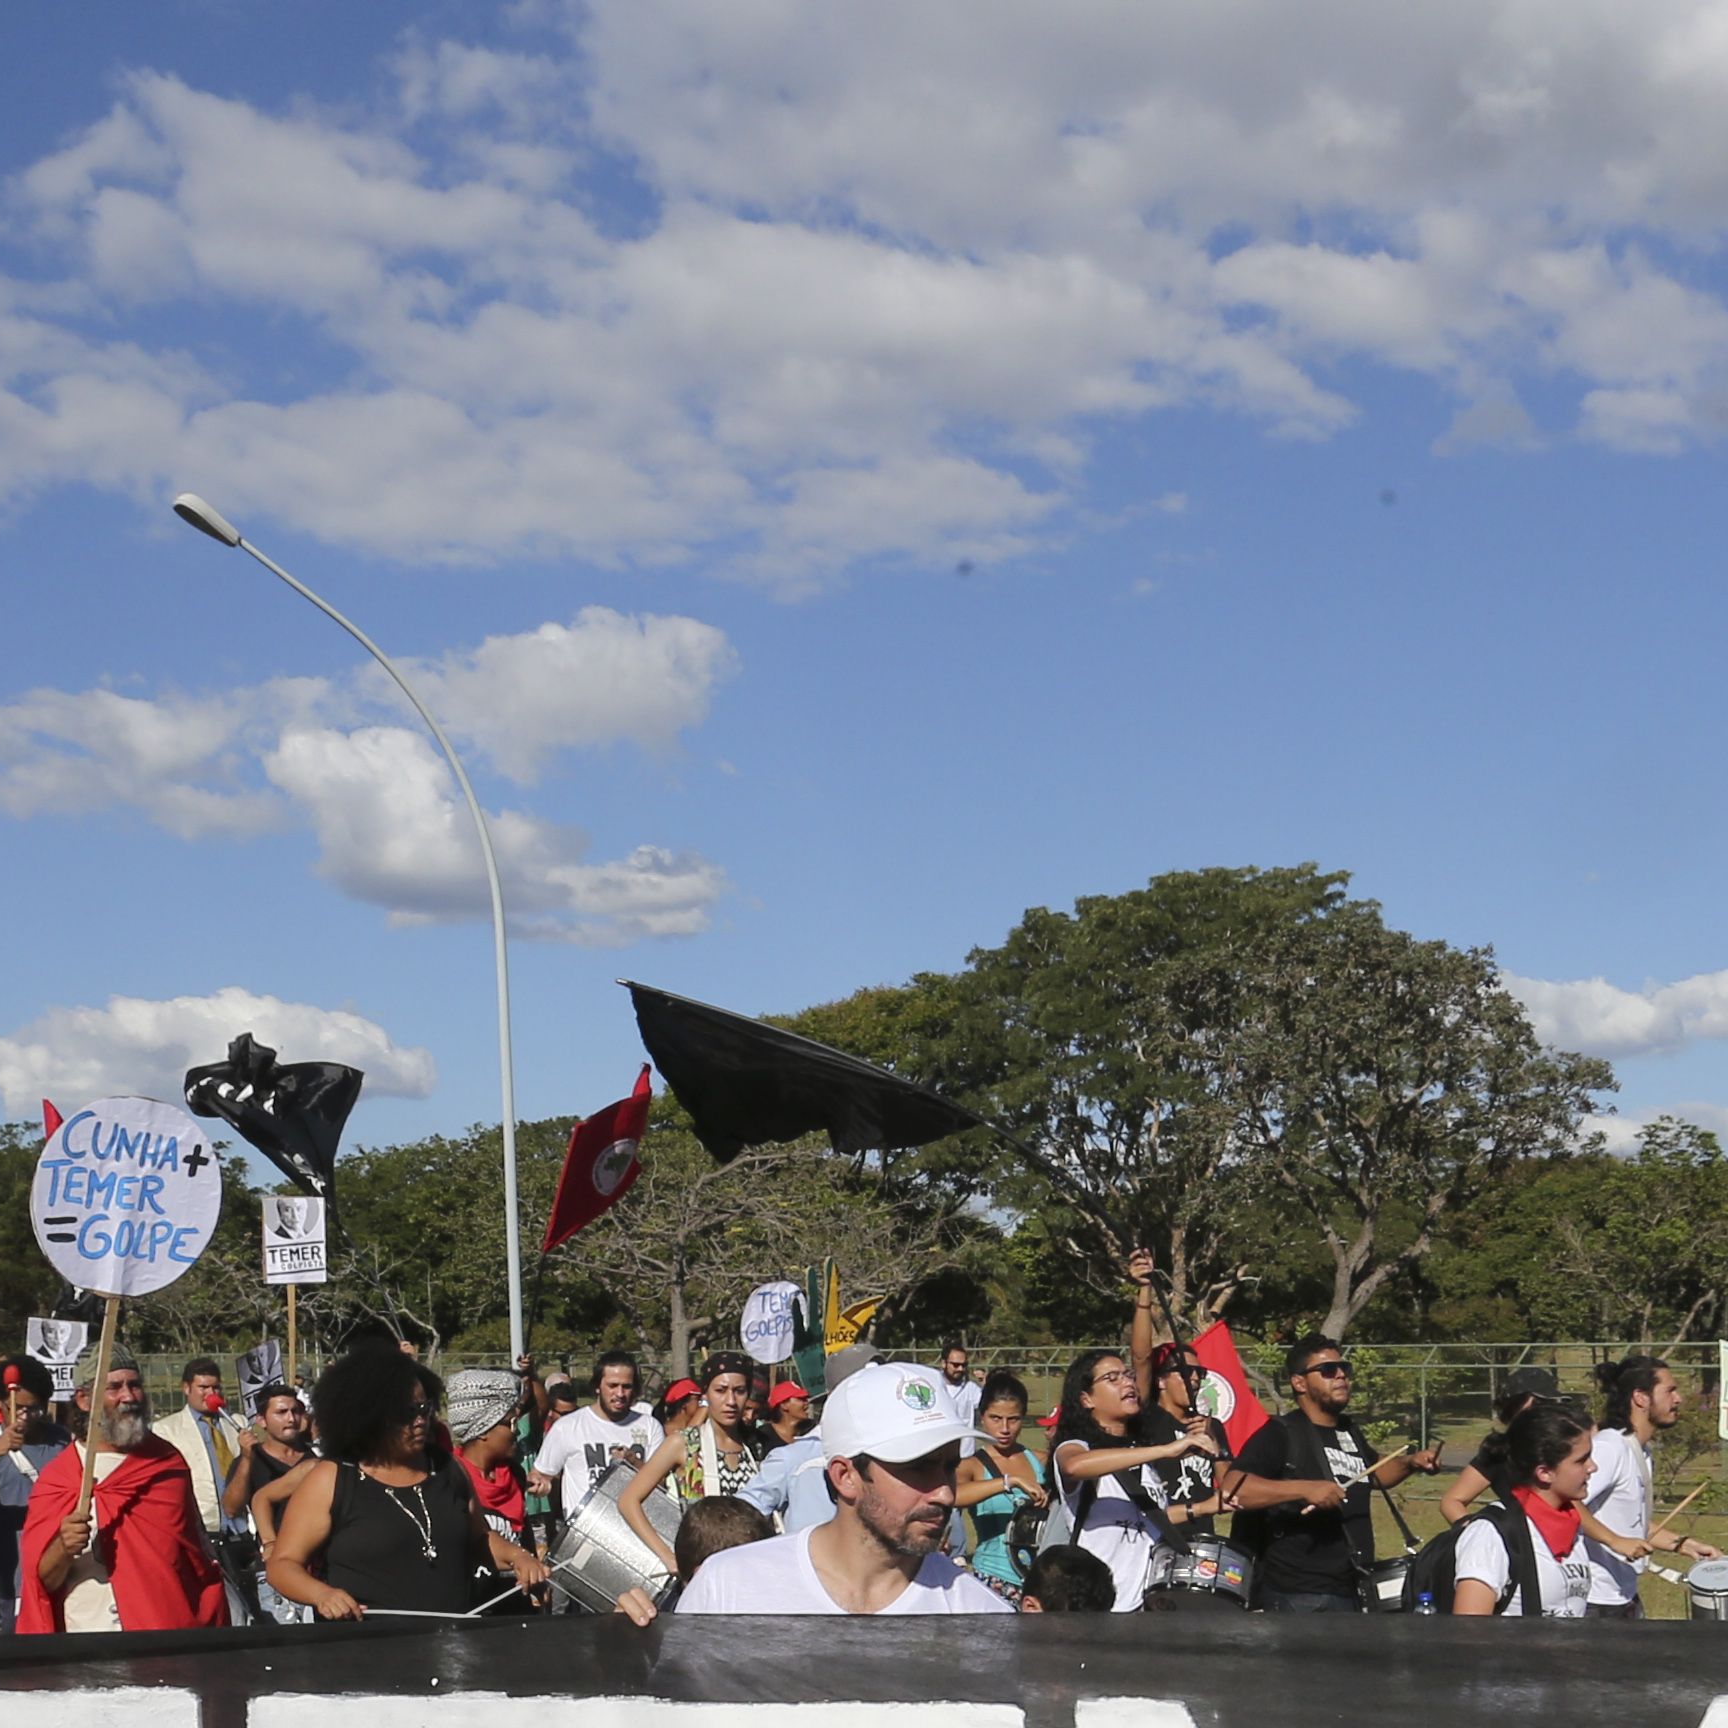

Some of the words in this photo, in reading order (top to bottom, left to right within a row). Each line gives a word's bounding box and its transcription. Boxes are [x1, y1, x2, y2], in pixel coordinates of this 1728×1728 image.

[61, 1110, 178, 1172] CUNHA
[40, 1159, 166, 1215] TEMER
[77, 1213, 200, 1264] GOLPE
[268, 1245, 323, 1265] TEMER
